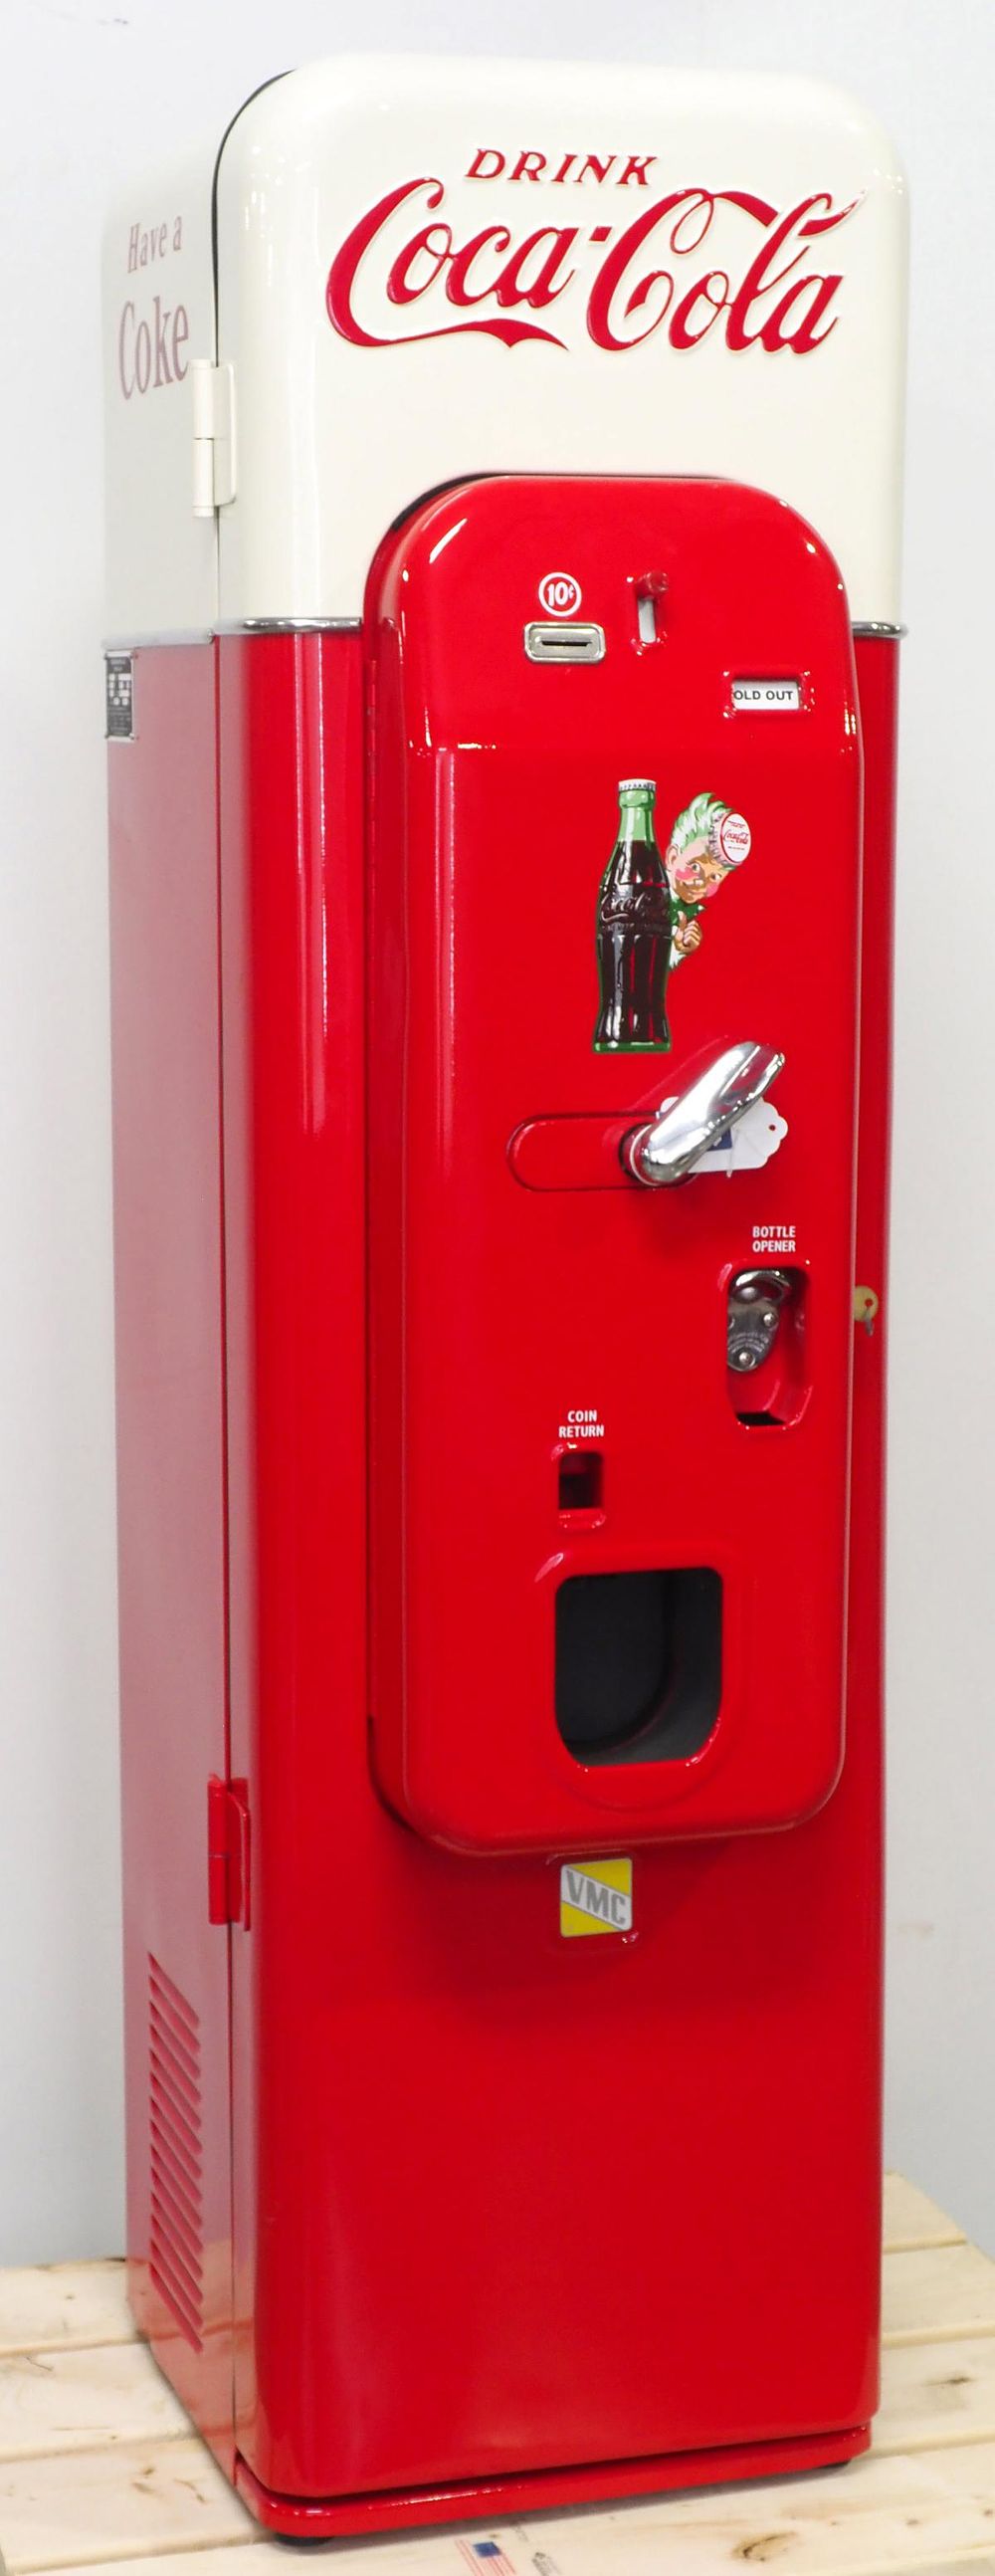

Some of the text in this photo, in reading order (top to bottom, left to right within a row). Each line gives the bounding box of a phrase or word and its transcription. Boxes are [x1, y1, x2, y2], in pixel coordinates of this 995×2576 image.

[466, 147, 658, 186] DRINK
[127, 215, 183, 274] Have a
[325, 177, 868, 353] Coca-Cola
[118, 295, 189, 400] Coke
[547, 581, 575, 607] 10¢
[765, 689, 794, 701] OUT
[752, 1225, 796, 1238] BOTTLE
[752, 1240, 796, 1252] OPENER
[567, 1409, 598, 1423] COIN
[558, 1424, 605, 1438] RETURN
[565, 1869, 627, 1926] VMC
